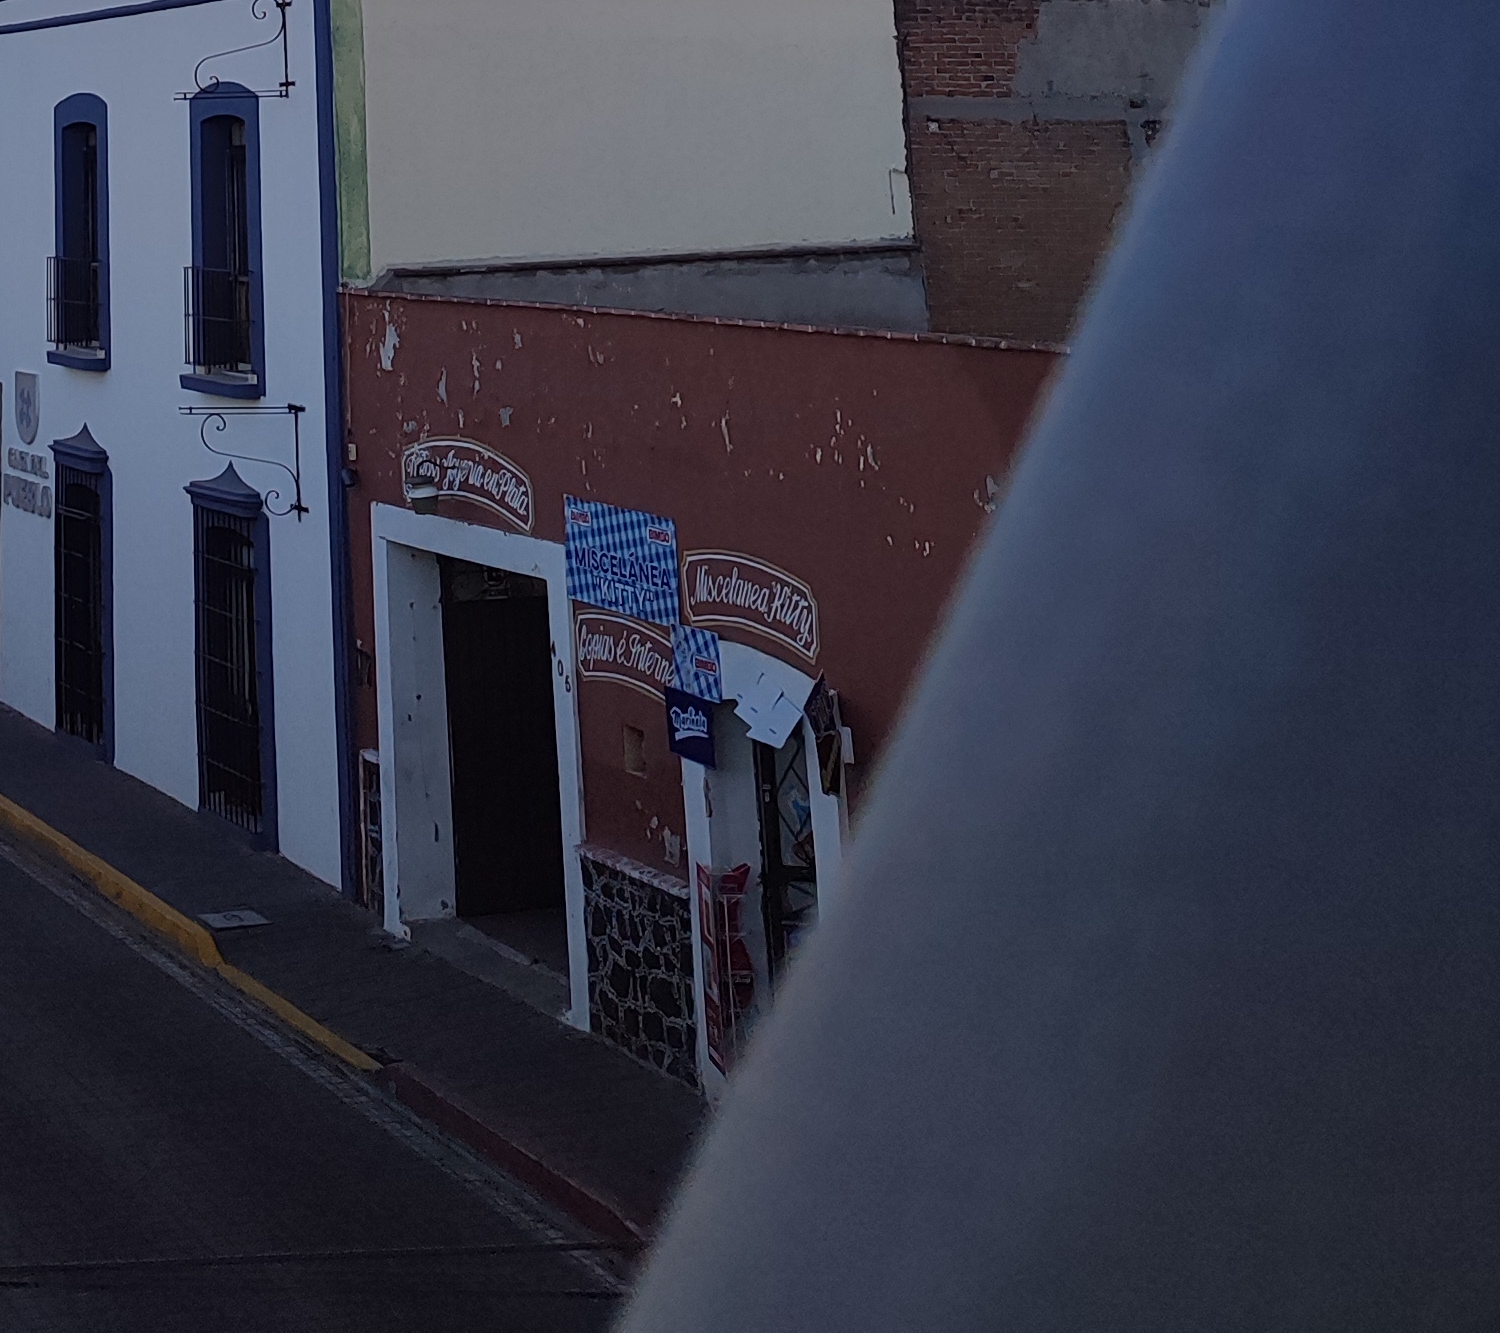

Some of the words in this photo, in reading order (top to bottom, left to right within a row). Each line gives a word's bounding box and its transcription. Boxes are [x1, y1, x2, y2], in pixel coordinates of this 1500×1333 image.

[495, 469, 528, 515] Plata
[574, 545, 672, 590] MISCELÁNEA
[690, 565, 769, 613] Miscelanea
[764, 581, 813, 646] Kitty
[580, 624, 614, 671] Copias
